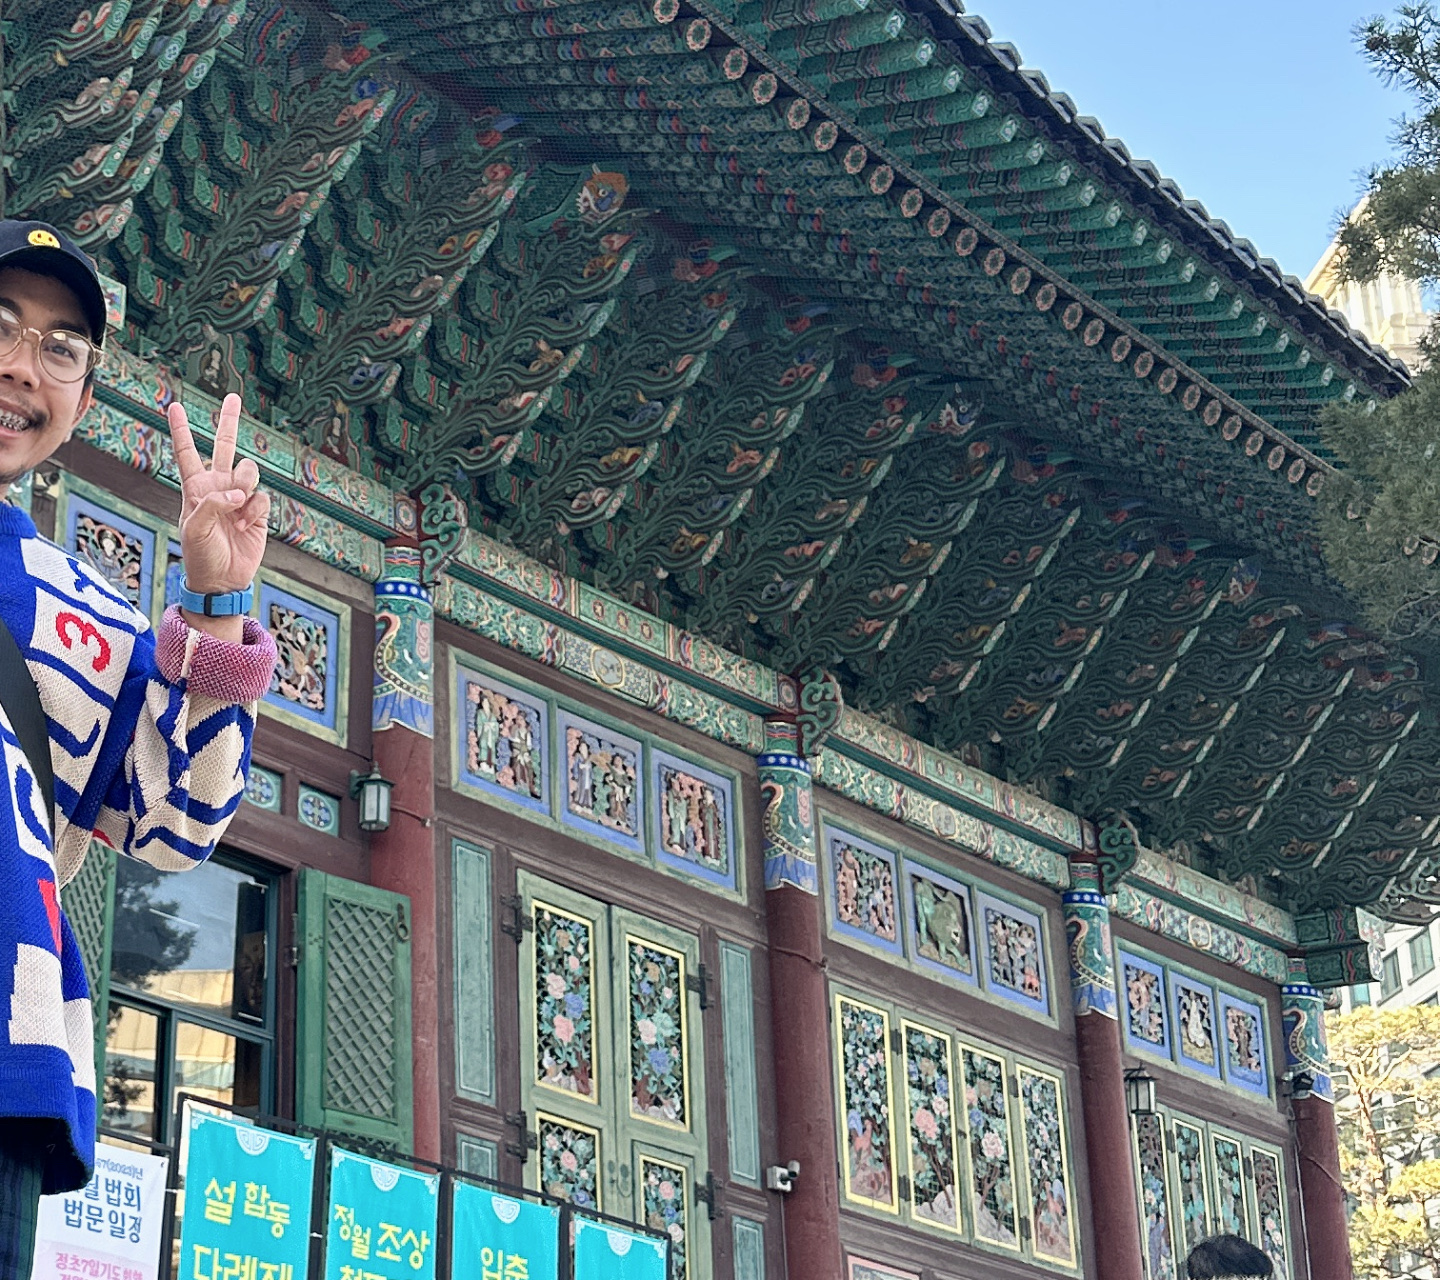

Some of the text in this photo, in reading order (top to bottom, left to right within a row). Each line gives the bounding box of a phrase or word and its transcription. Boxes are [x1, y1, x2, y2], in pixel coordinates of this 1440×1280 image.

[205, 1177, 291, 1238] 설 합동
[334, 1203, 430, 1269] 정월 조상
